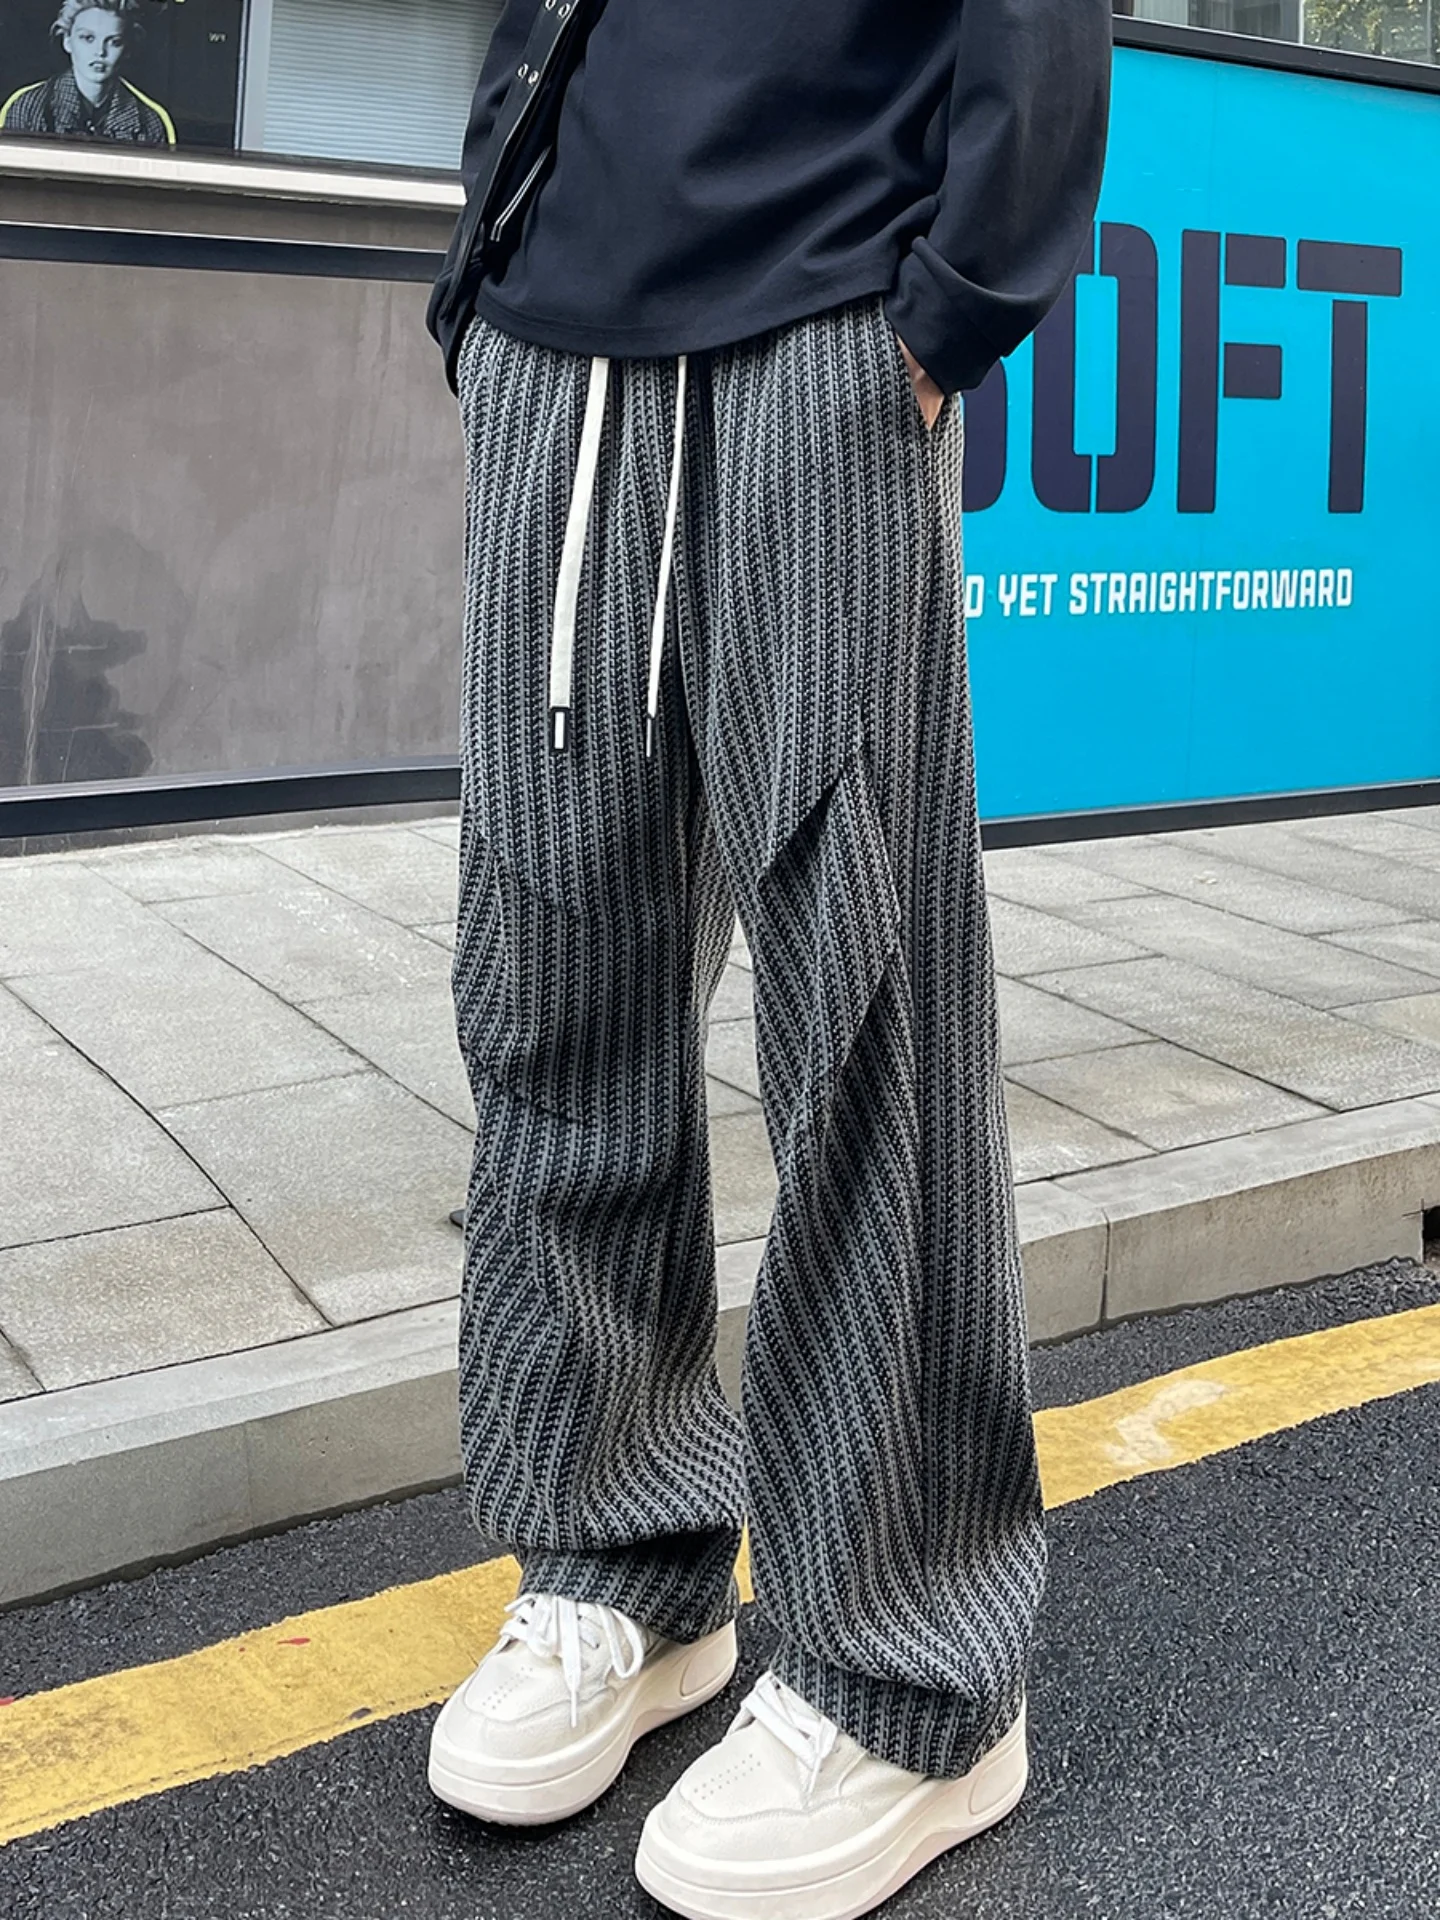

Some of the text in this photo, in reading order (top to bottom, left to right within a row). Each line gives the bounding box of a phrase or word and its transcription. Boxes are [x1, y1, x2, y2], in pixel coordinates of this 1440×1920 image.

[963, 221, 1402, 514] OFT
[998, 574, 1058, 616] YET
[1069, 569, 1353, 614] STRAIGHTFORWARD
